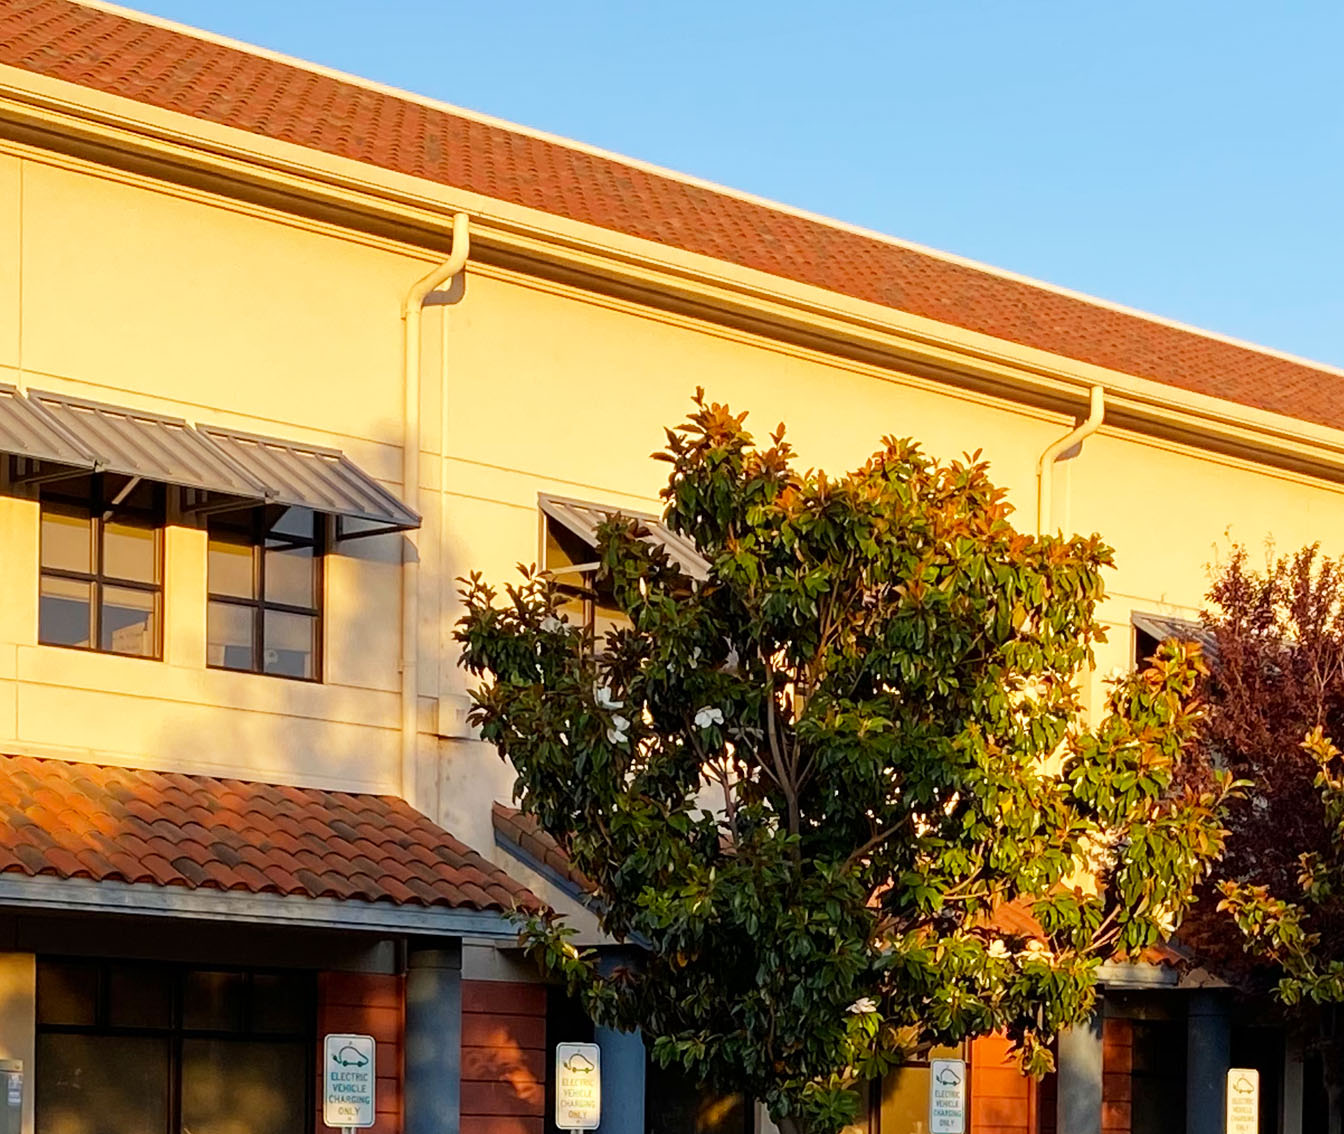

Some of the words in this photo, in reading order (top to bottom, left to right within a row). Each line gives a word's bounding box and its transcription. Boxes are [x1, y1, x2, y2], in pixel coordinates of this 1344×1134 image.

[331, 1072, 368, 1082] ELECTRIC
[332, 1084, 367, 1093] VEHICLE
[328, 1095, 370, 1104] CHARGING
[338, 1107, 361, 1116] ONLY
